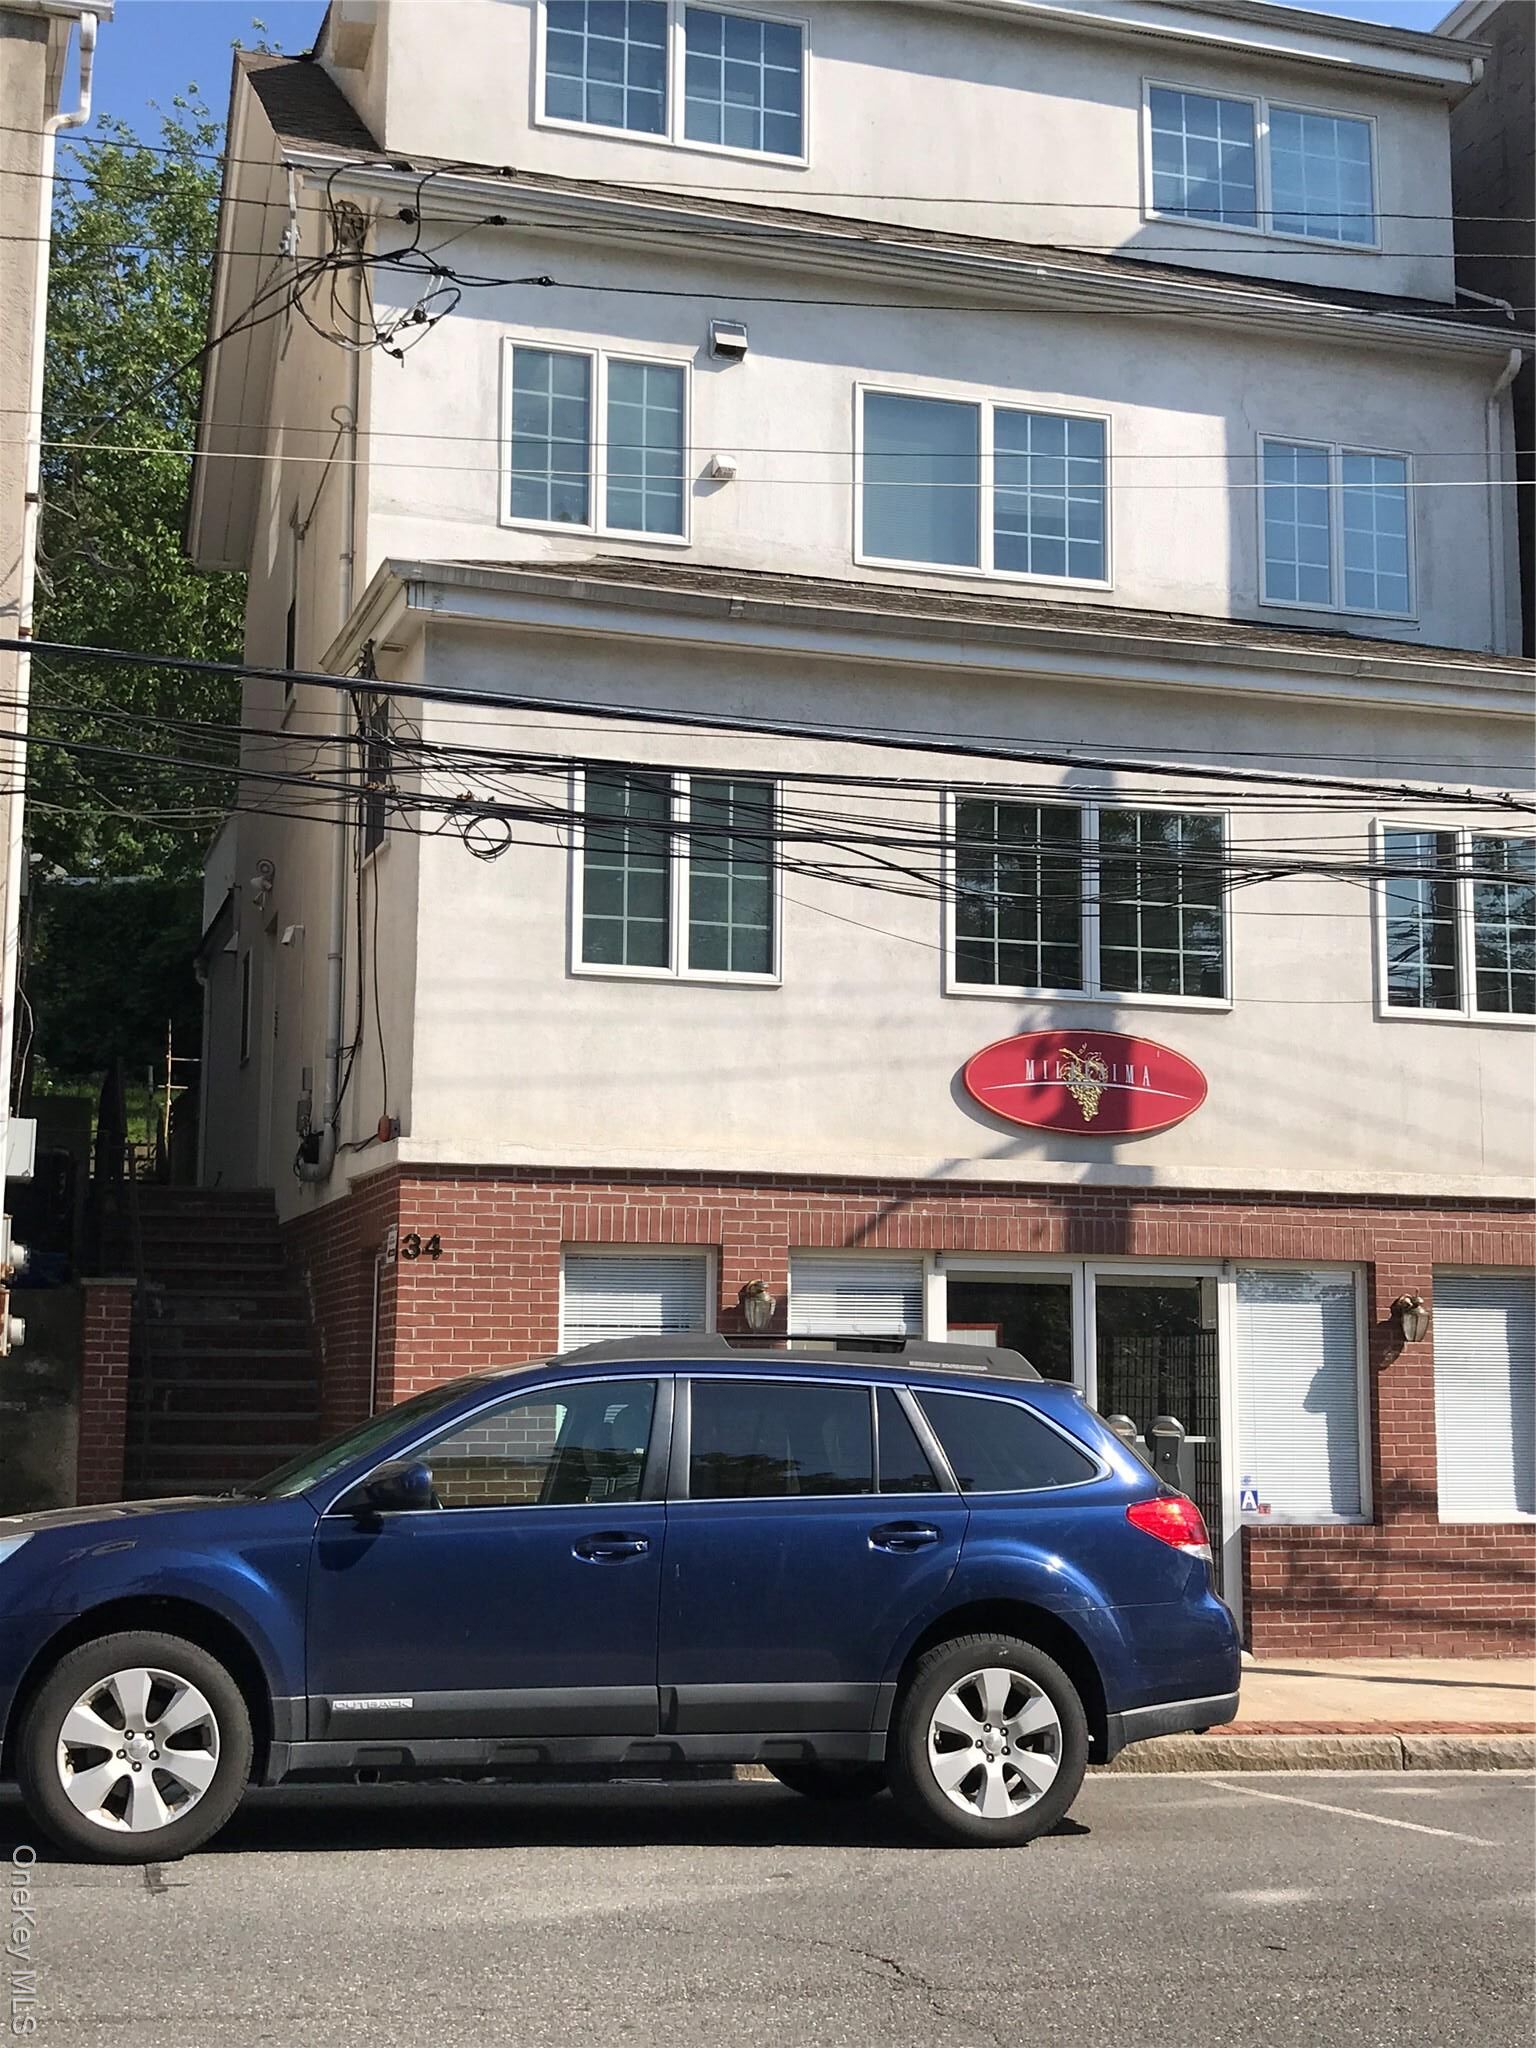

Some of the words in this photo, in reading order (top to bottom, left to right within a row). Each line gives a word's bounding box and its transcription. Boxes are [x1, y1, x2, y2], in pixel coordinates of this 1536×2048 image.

[401, 1233, 443, 1260] 34
[1241, 1490, 1257, 1509] A
[333, 1698, 413, 1710] OUTBACK
